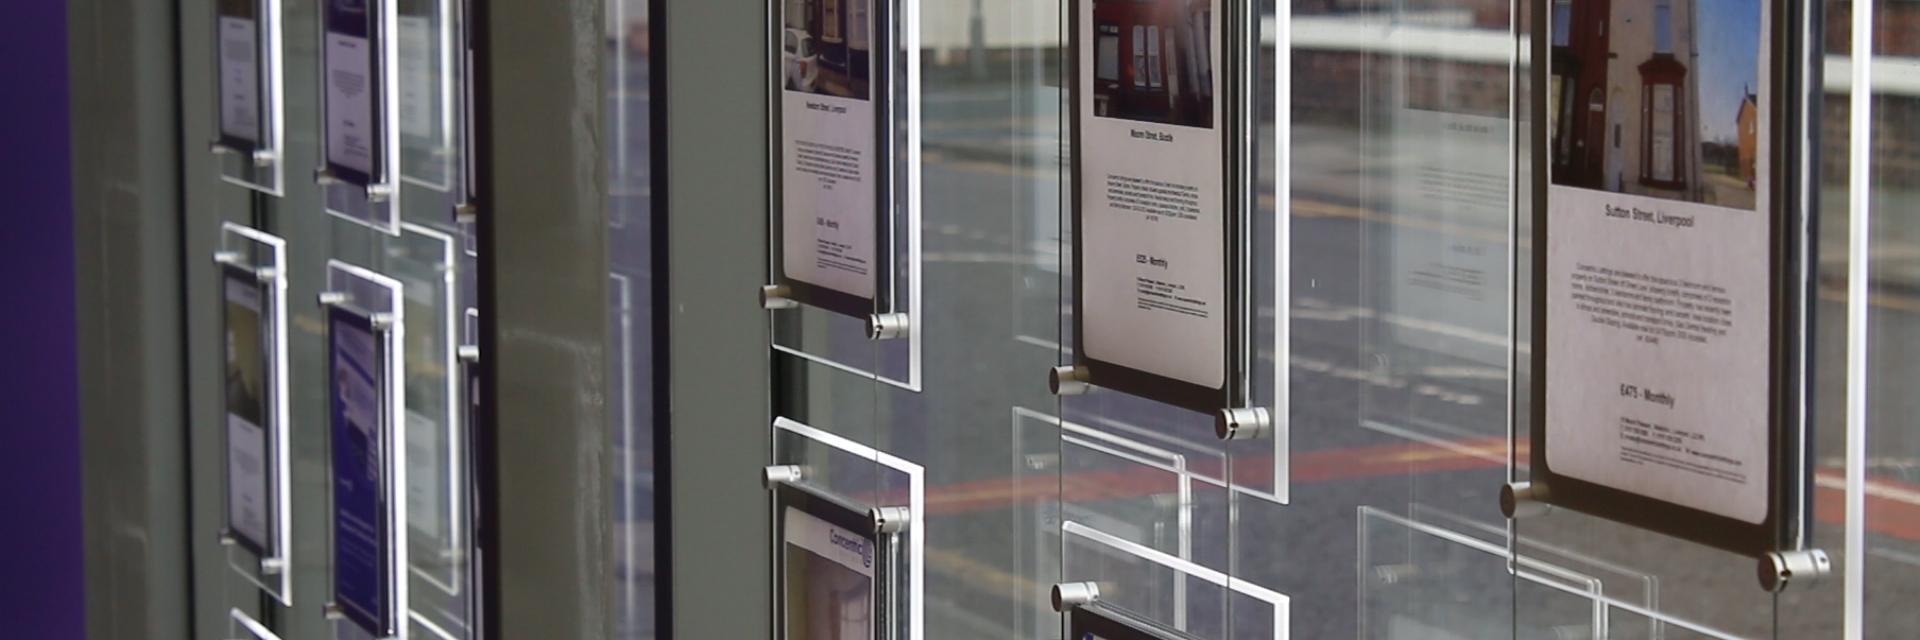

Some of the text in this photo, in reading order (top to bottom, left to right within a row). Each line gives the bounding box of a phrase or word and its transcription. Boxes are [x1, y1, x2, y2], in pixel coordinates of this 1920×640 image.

[1605, 203, 1631, 220] Sutton
[1657, 212, 1695, 228] Liverpool
[1644, 388, 1675, 409] Monthly
